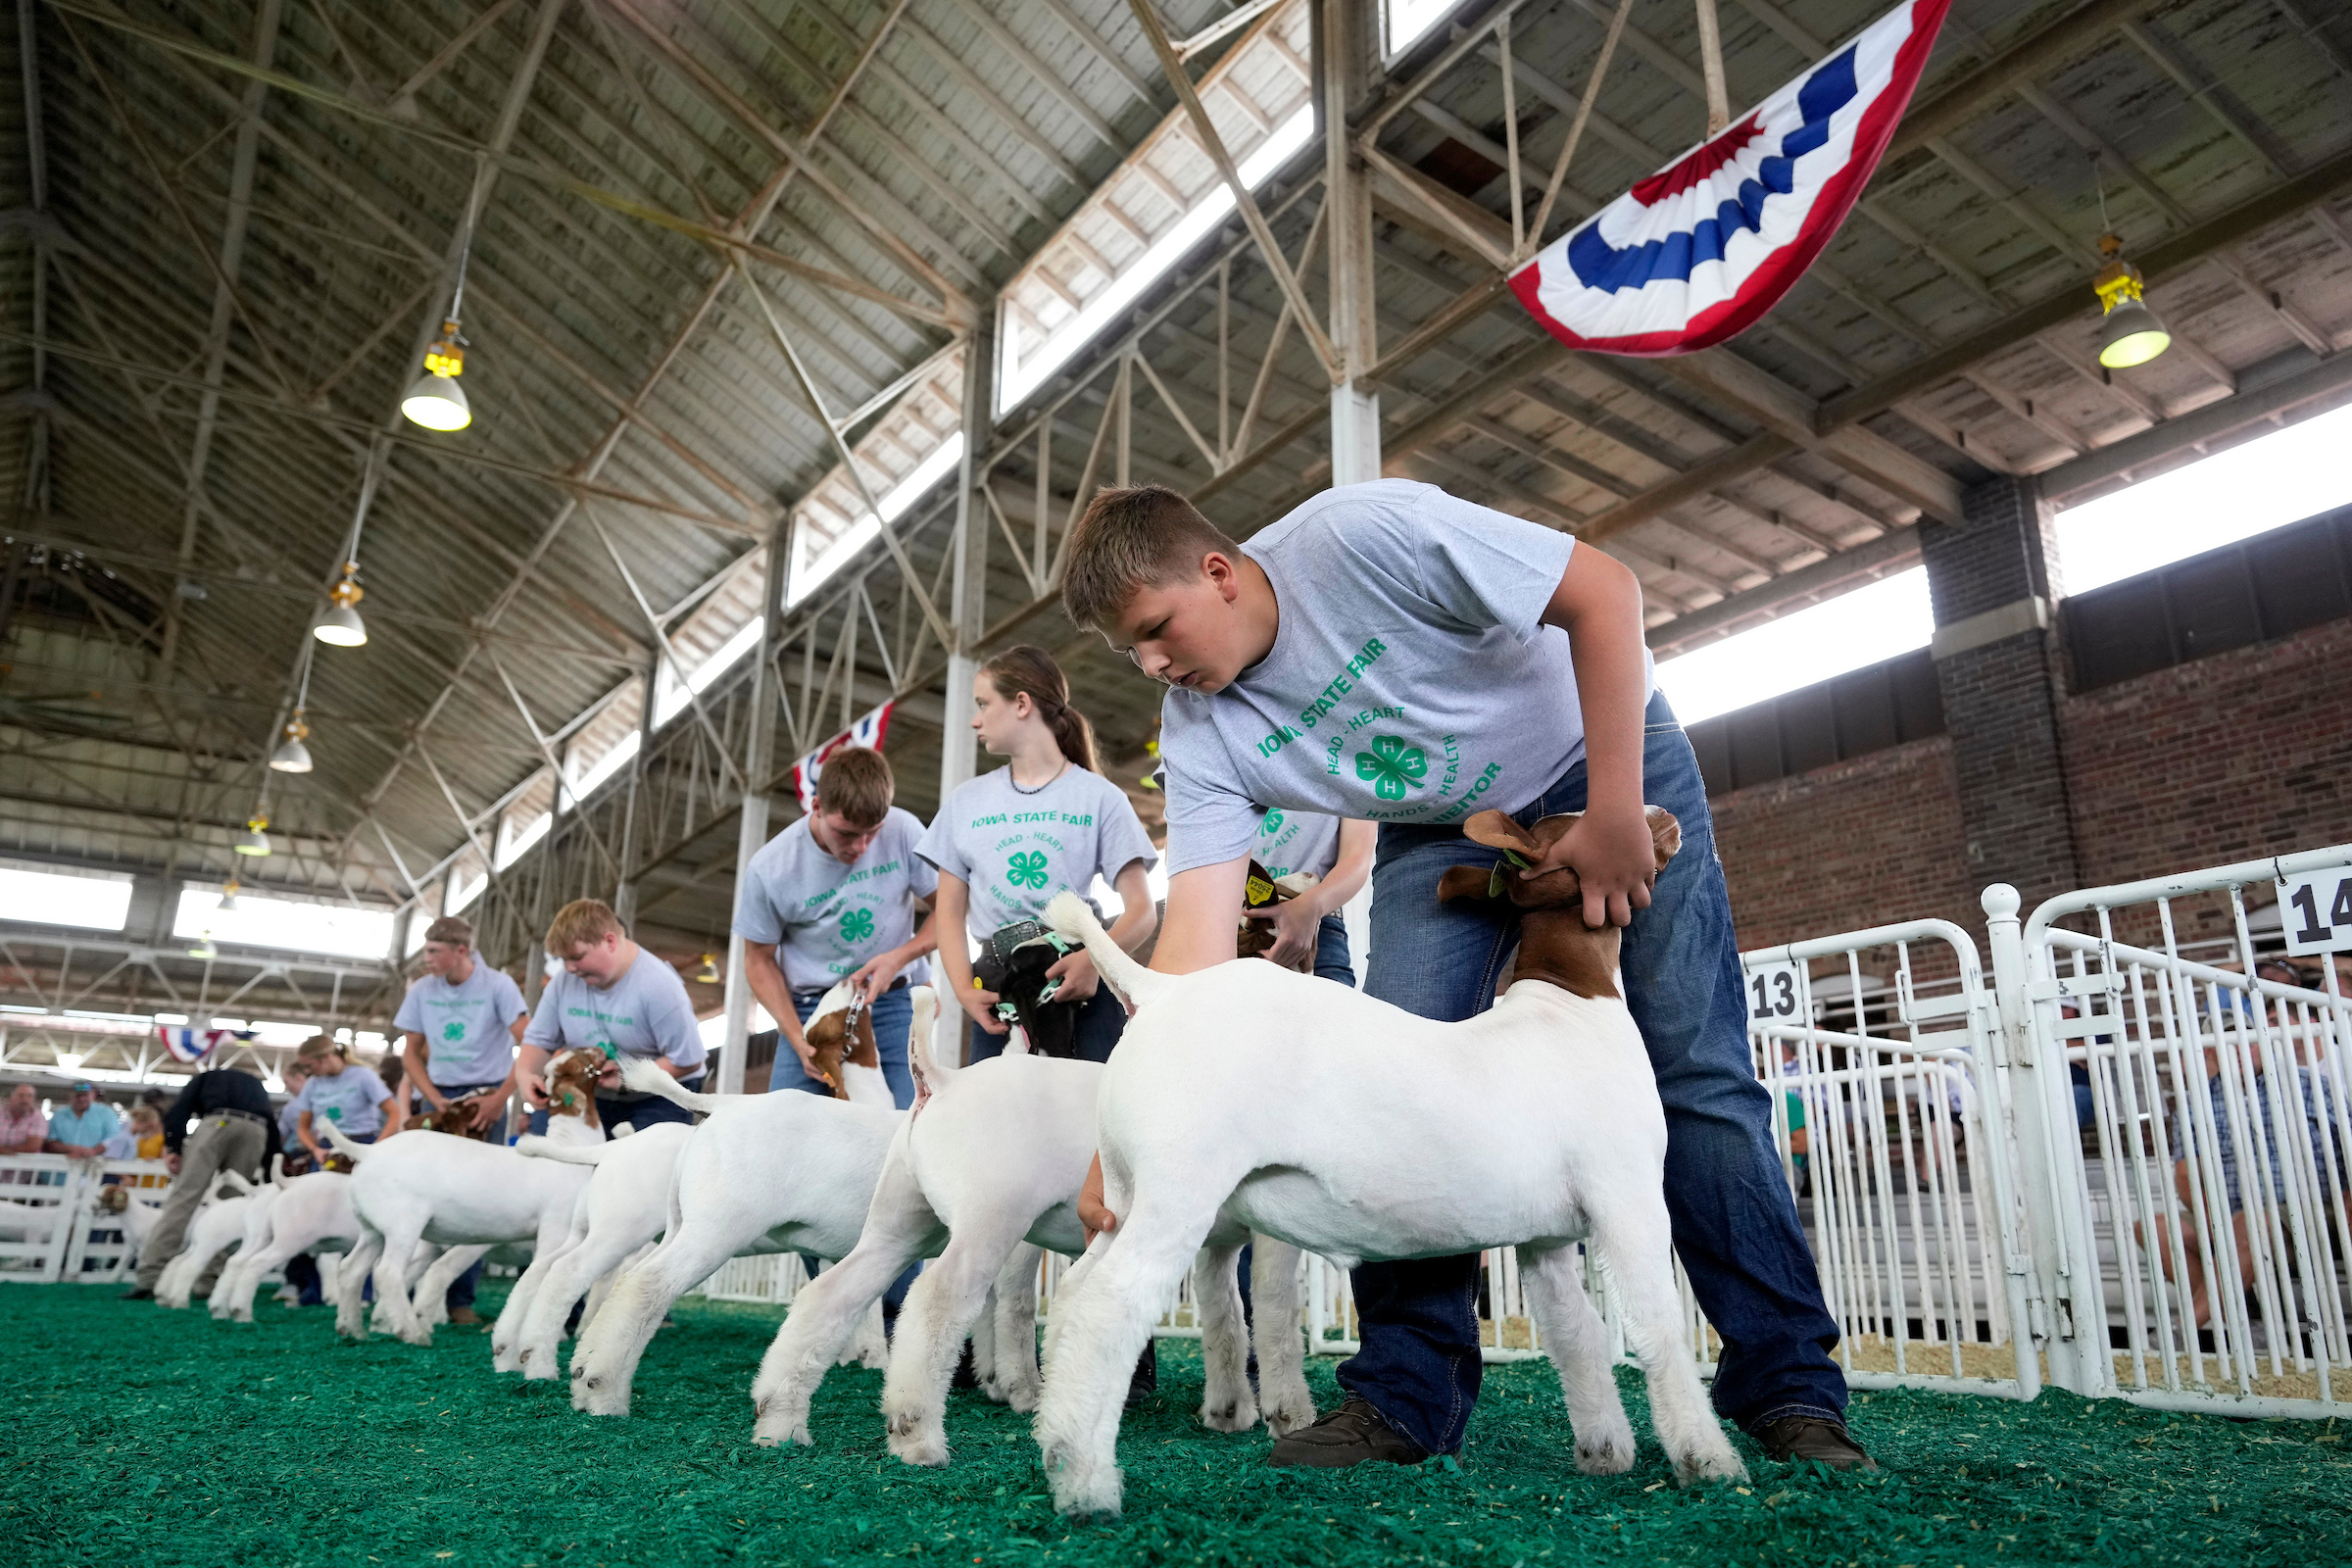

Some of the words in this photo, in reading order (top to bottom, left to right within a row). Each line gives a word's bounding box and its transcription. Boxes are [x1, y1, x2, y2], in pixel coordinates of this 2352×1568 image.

[1257, 725, 1303, 759] IOWA
[1300, 674, 1352, 728] STATE
[1346, 638, 1388, 680] FAIR
[1327, 736, 1344, 775] HEAD
[1348, 707, 1405, 731] HEART
[1382, 741, 1395, 755] H
[1362, 760, 1376, 771] H
[1366, 804, 1429, 819] HANDS
[1438, 734, 1459, 796] HEALTH
[1405, 757, 1420, 770] H
[1384, 780, 1396, 794] H
[971, 812, 1007, 829] IOWA
[1012, 809, 1057, 824] STATE
[1061, 813, 1093, 827] FAIR
[995, 834, 1023, 853] HEAD
[1033, 831, 1064, 853] HEART
[1262, 823, 1300, 857] HALTH
[805, 888, 837, 907] IOWA
[872, 861, 899, 877] FAIR
[990, 884, 1022, 909] HANDS
[2291, 878, 2352, 944] 14
[1752, 971, 1795, 1018] 13
